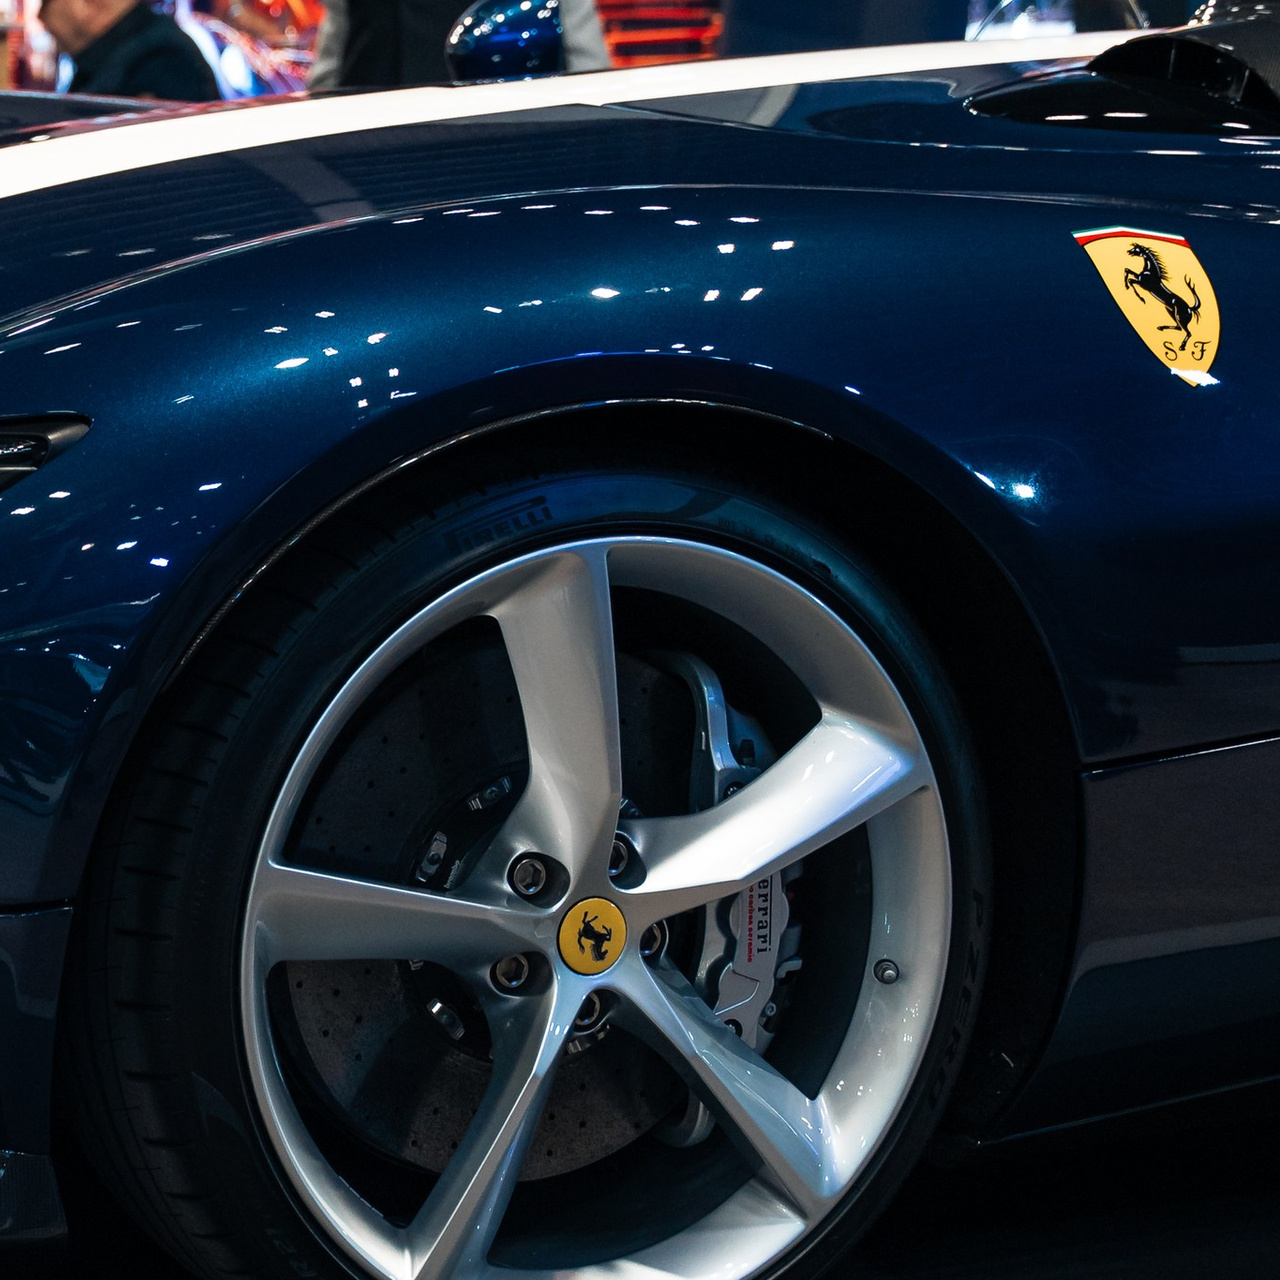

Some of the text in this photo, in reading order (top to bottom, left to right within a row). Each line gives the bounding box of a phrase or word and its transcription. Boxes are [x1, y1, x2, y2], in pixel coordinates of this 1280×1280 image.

[1163, 340, 1212, 361] S F
[443, 495, 552, 556] PIRELLI
[443, 859, 460, 889] brembo
[757, 876, 773, 954] errari
